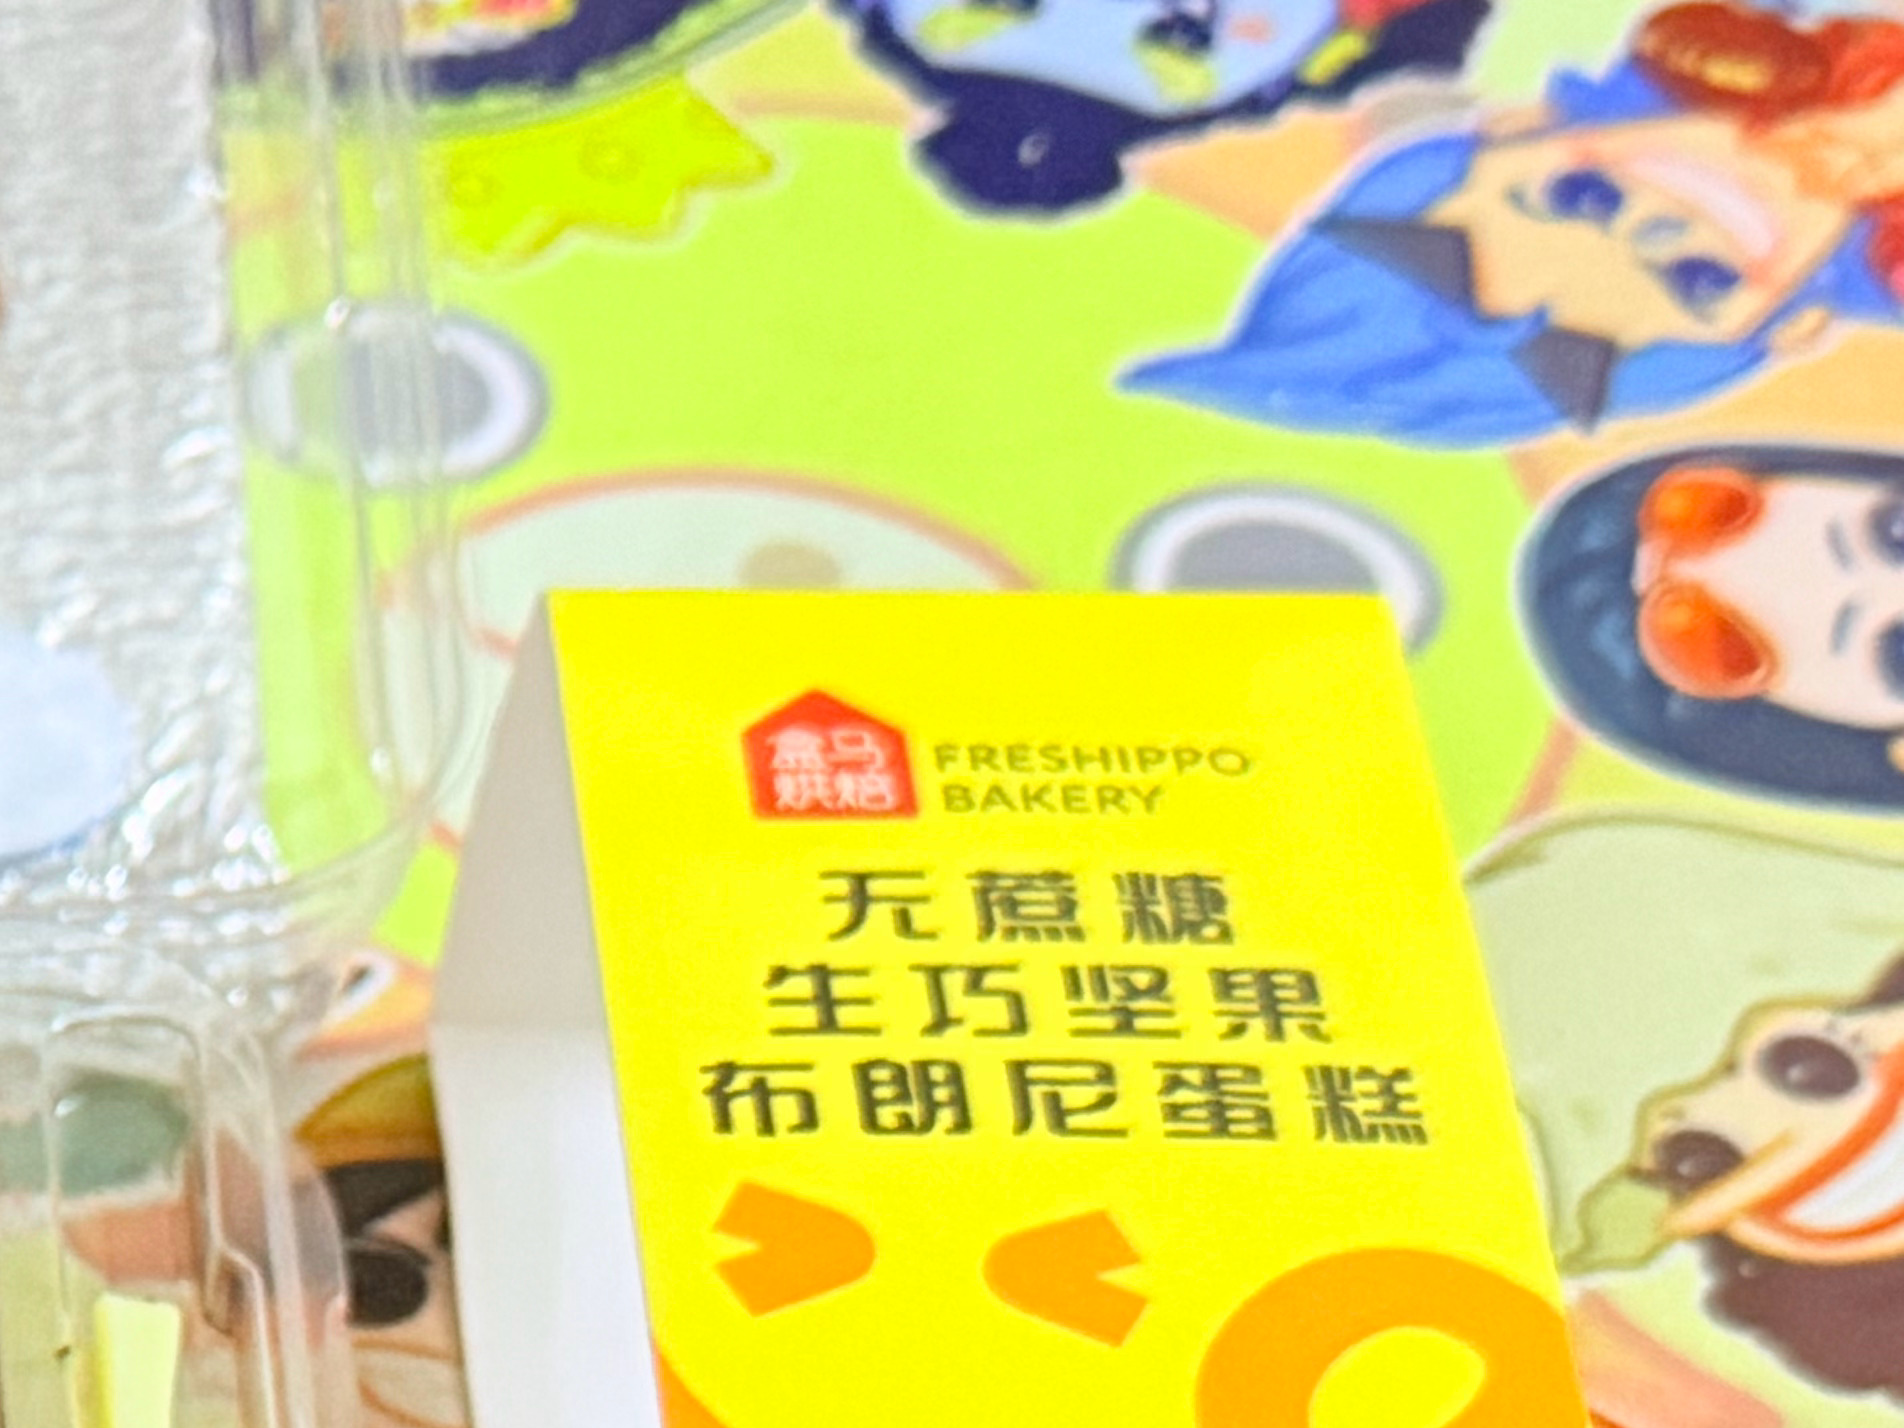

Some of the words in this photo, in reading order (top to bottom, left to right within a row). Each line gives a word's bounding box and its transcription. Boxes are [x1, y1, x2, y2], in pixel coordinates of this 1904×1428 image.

[770, 727, 884, 773] 盒马
[932, 740, 1252, 778] FRESHIPPO
[774, 772, 895, 812] 烘焙
[941, 784, 1163, 815] BAKERY
[817, 868, 1235, 946] 无蔗糖
[762, 962, 1335, 1044] 生巧坚果
[700, 1058, 1430, 1147] 布朗尼蛋糕
